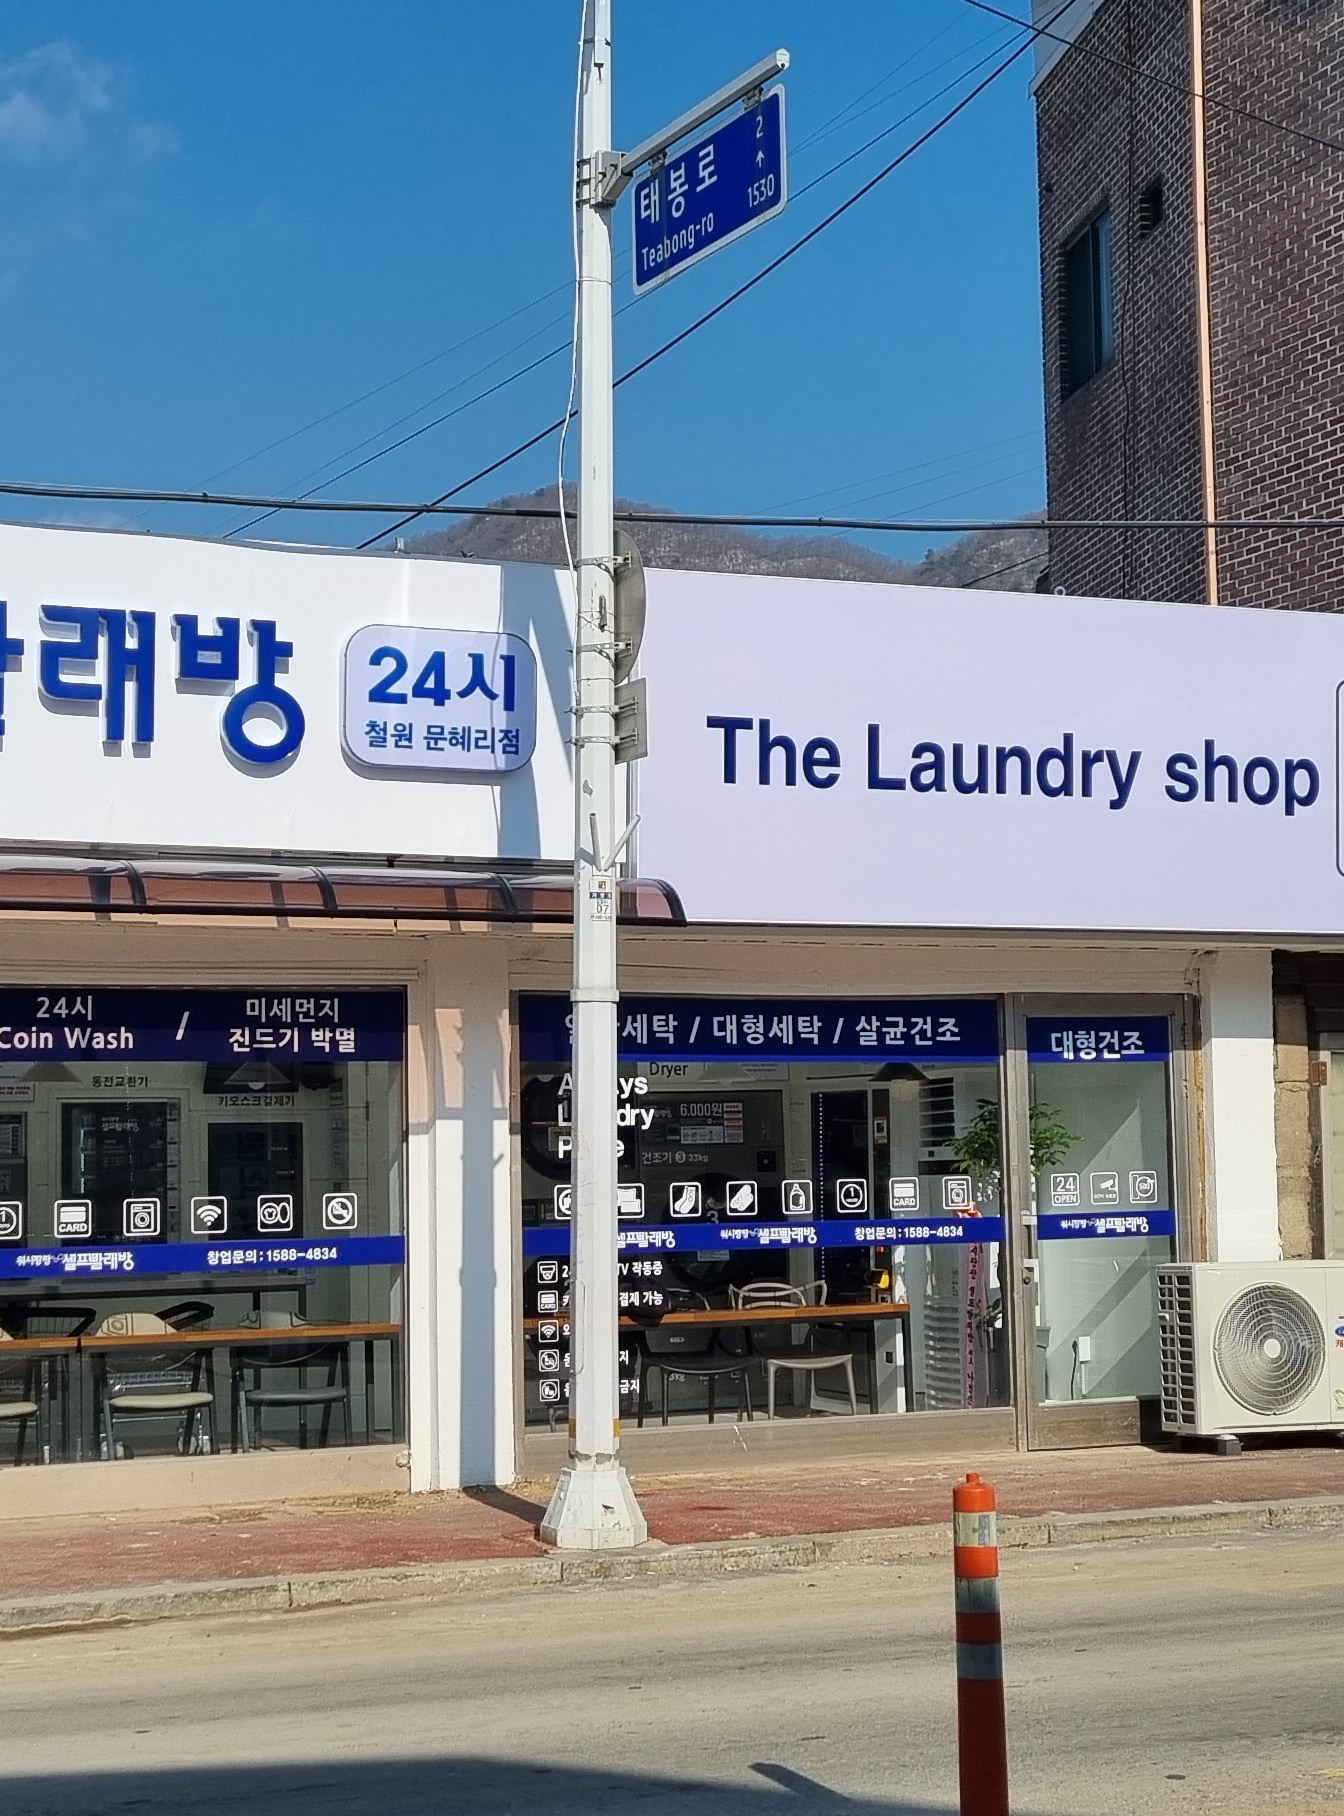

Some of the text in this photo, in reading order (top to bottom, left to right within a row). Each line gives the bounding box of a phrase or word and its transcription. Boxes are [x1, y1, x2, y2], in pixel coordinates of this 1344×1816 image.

[756, 115, 763, 139] 2
[640, 143, 718, 224] 태봉로
[747, 173, 775, 208] 1530
[641, 212, 714, 271] Teabong-ro
[368, 645, 516, 712] 24시
[364, 720, 520, 755] 철원 문혜리점
[706, 715, 1320, 816] The Laundry shop
[36, 997, 93, 1020] 24시
[246, 998, 339, 1023] 미세먼지
[64, 1027, 134, 1049] Wash
[229, 1028, 355, 1053] 진드기 박멸
[712, 1014, 822, 1045] 대형세탁
[855, 1016, 961, 1046] 살균건조
[1051, 1030, 1145, 1060] 대형건조
[92, 1075, 149, 1088] 동전교환기
[649, 1062, 688, 1078] Dryer
[558, 1073, 649, 1099] Ays
[558, 1103, 655, 1130] Ldry
[1056, 1177, 1075, 1192] 24
[893, 1197, 916, 1206] CARD
[1054, 1195, 1076, 1203] OPEN
[59, 1223, 87, 1233] CARD
[759, 1227, 817, 1244] 셀프빨래방
[1095, 1217, 1149, 1233] 셀프빨래방
[62, 1252, 134, 1271] 셀프빨래방
[632, 1261, 663, 1276] 작동중
[619, 1291, 664, 1307] 결제 가능
